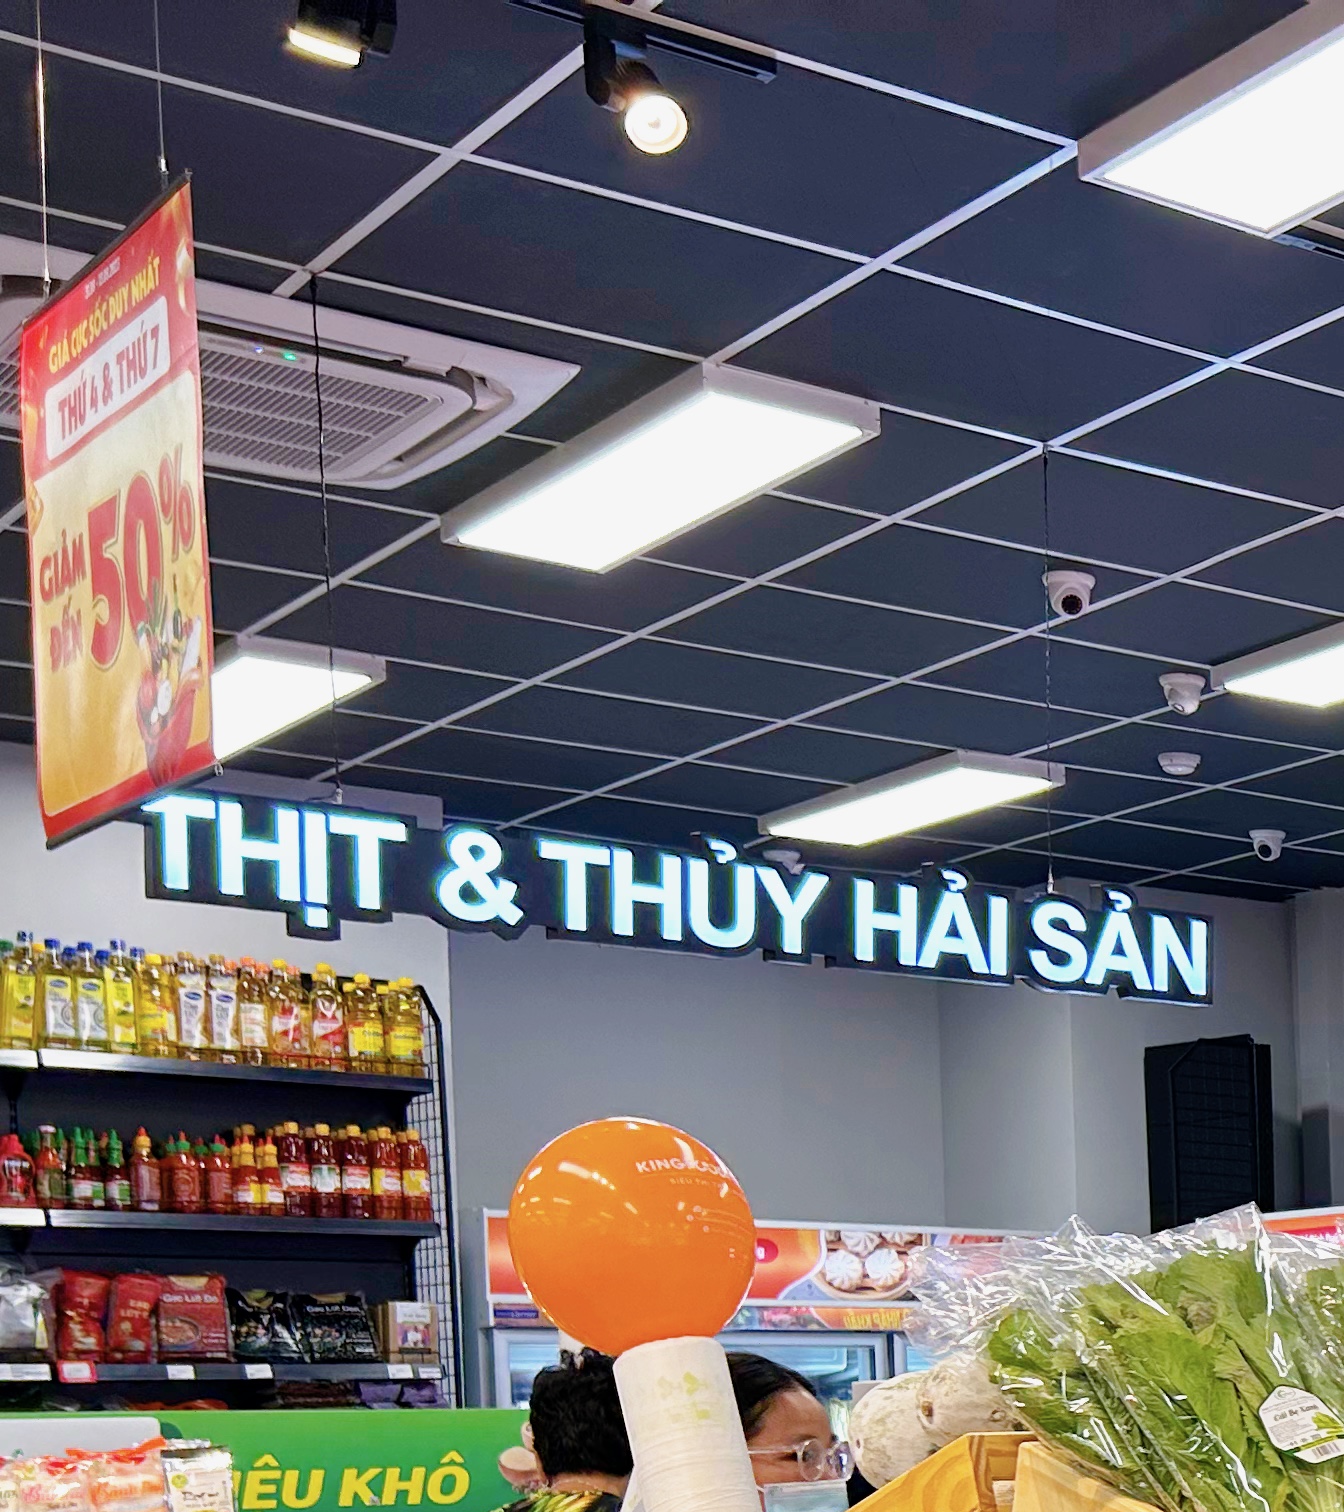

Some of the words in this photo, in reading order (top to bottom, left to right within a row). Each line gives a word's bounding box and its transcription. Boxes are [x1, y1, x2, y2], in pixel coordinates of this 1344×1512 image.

[49, 331, 70, 374] GIÁ
[71, 320, 88, 359] CỰC
[89, 296, 109, 342] SỐC
[109, 283, 130, 325] DUY
[131, 249, 160, 307] NHẤT
[58, 368, 87, 441] THỨ
[89, 375, 98, 414] 4
[102, 362, 113, 407] &
[116, 320, 148, 395] THỨ
[150, 323, 160, 370] 7
[39, 528, 87, 603] GIẢM
[88, 443, 196, 671] 50%
[50, 596, 84, 673] ĐẾN
[142, 795, 408, 929] THỊT
[436, 827, 523, 927] &
[537, 834, 832, 954] THỦY
[853, 866, 1012, 978] HẢI
[1026, 889, 1208, 996] SẢN
[338, 1449, 471, 1507] KHÔ
